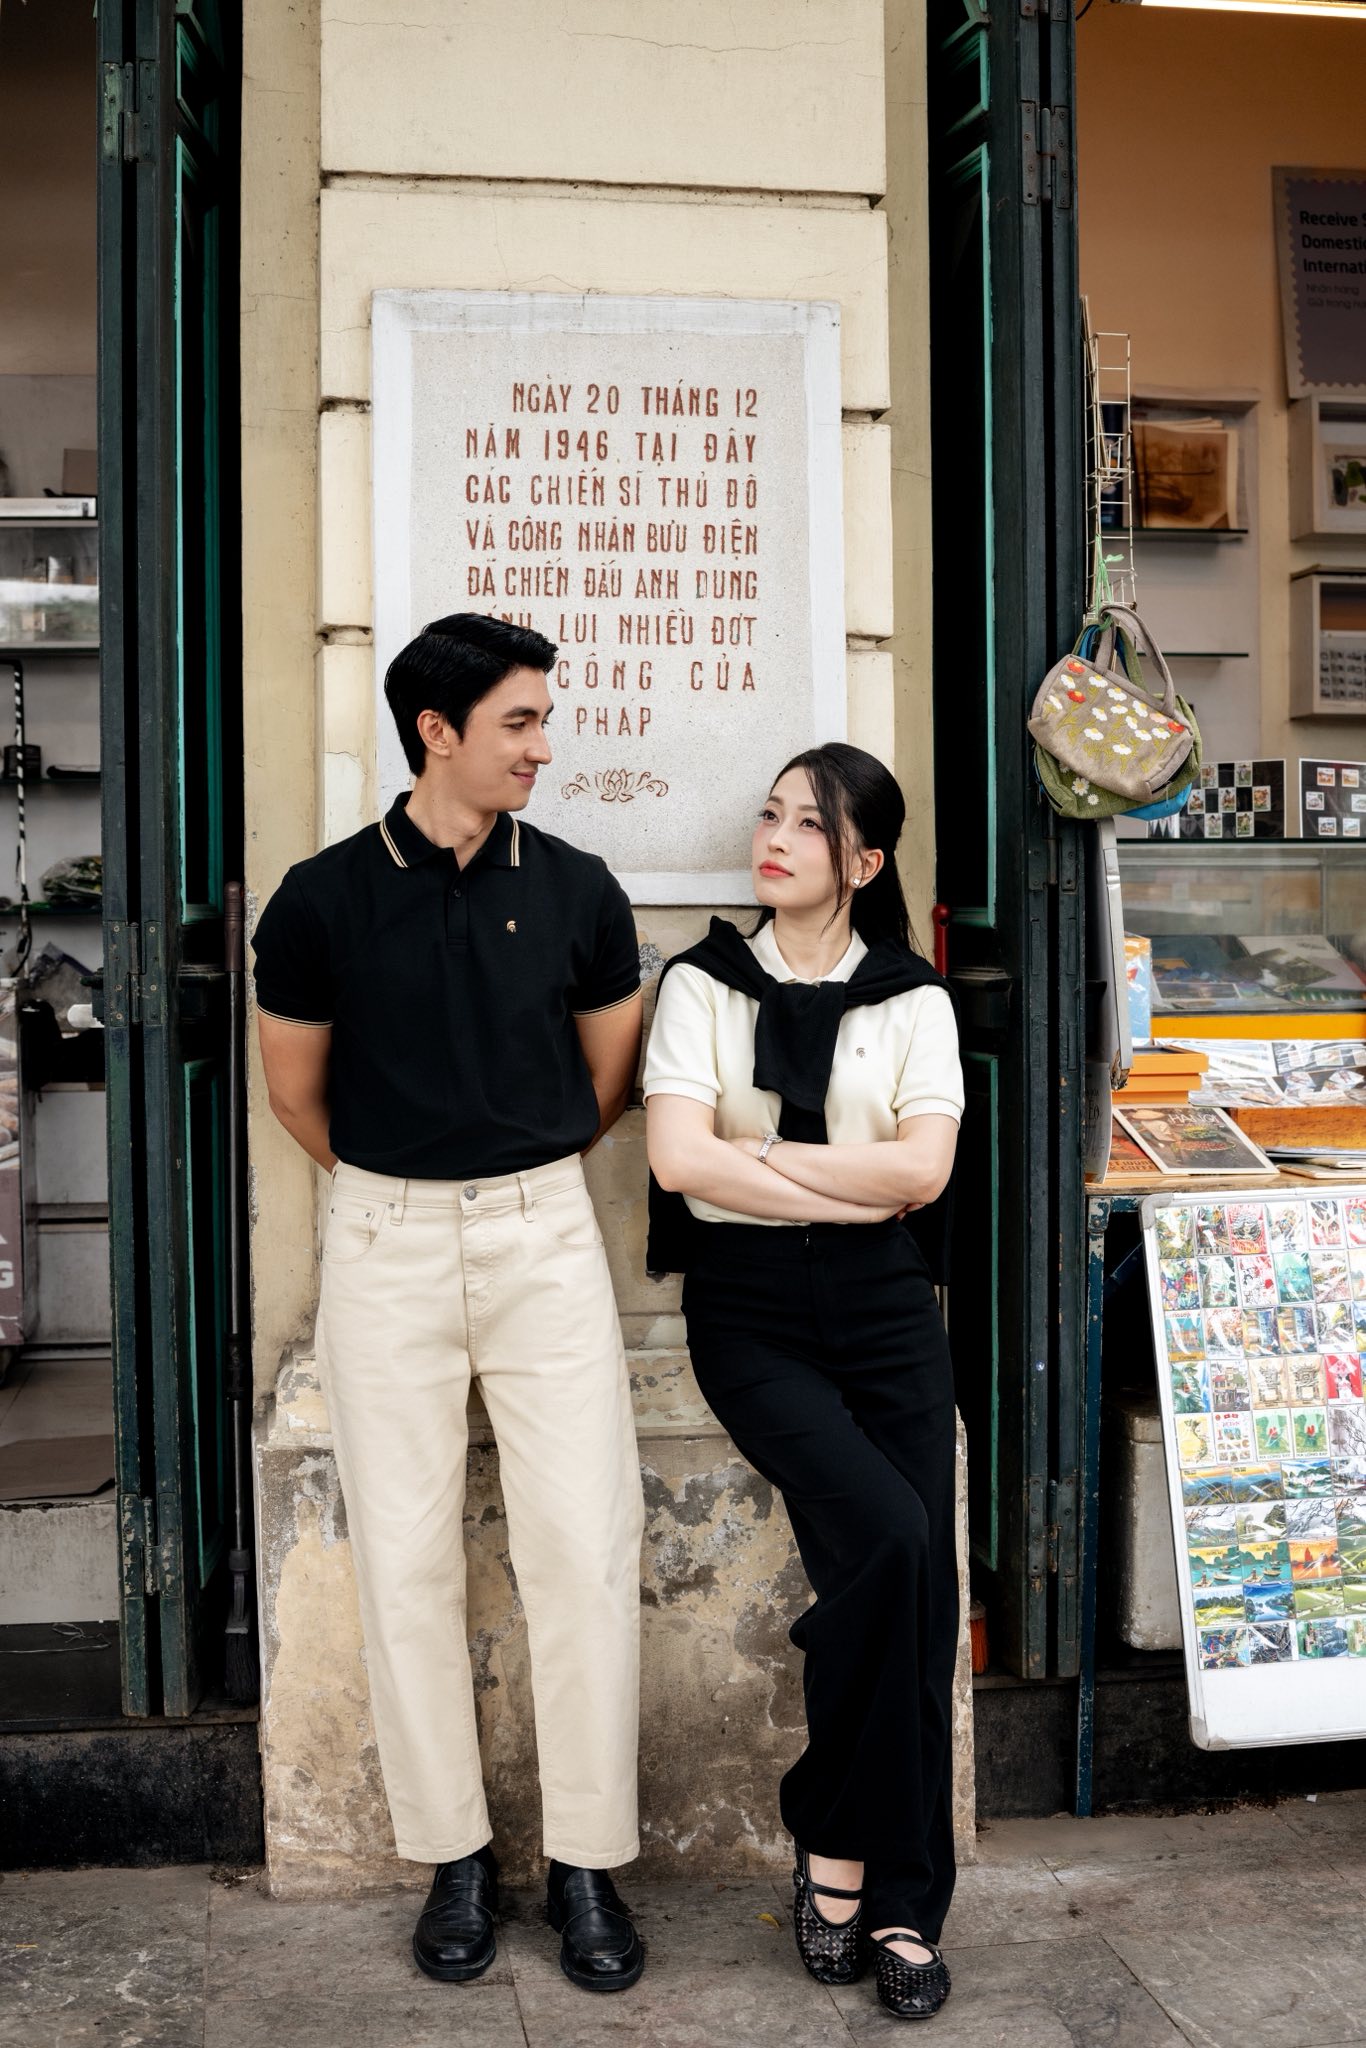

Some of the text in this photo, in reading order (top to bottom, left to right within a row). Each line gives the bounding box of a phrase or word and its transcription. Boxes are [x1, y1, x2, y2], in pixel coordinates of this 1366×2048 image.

[1299, 210, 1358, 227] Receive
[513, 374, 758, 418] NGÀY 20 THÁNG 12
[466, 422, 520, 459] NĂM
[635, 432, 677, 467] TẠI
[704, 427, 756, 463] ĐÂY
[465, 466, 511, 504] CÁC
[530, 467, 605, 506] CHIẾN
[658, 471, 708, 508] THỦ
[726, 473, 758, 509] ĐÔ
[508, 515, 562, 552] CÔNG
[578, 516, 635, 553] NHÂN
[647, 519, 688, 553] BƯU
[703, 518, 758, 560] ĐIỆN
[467, 558, 496, 597] ĐÃ
[505, 557, 569, 597] CHIẾN
[584, 559, 622, 598] ĐẤU
[635, 568, 679, 599] ANH
[619, 608, 694, 645] NHIỀU
[557, 652, 756, 691] CÔNG CỦA
